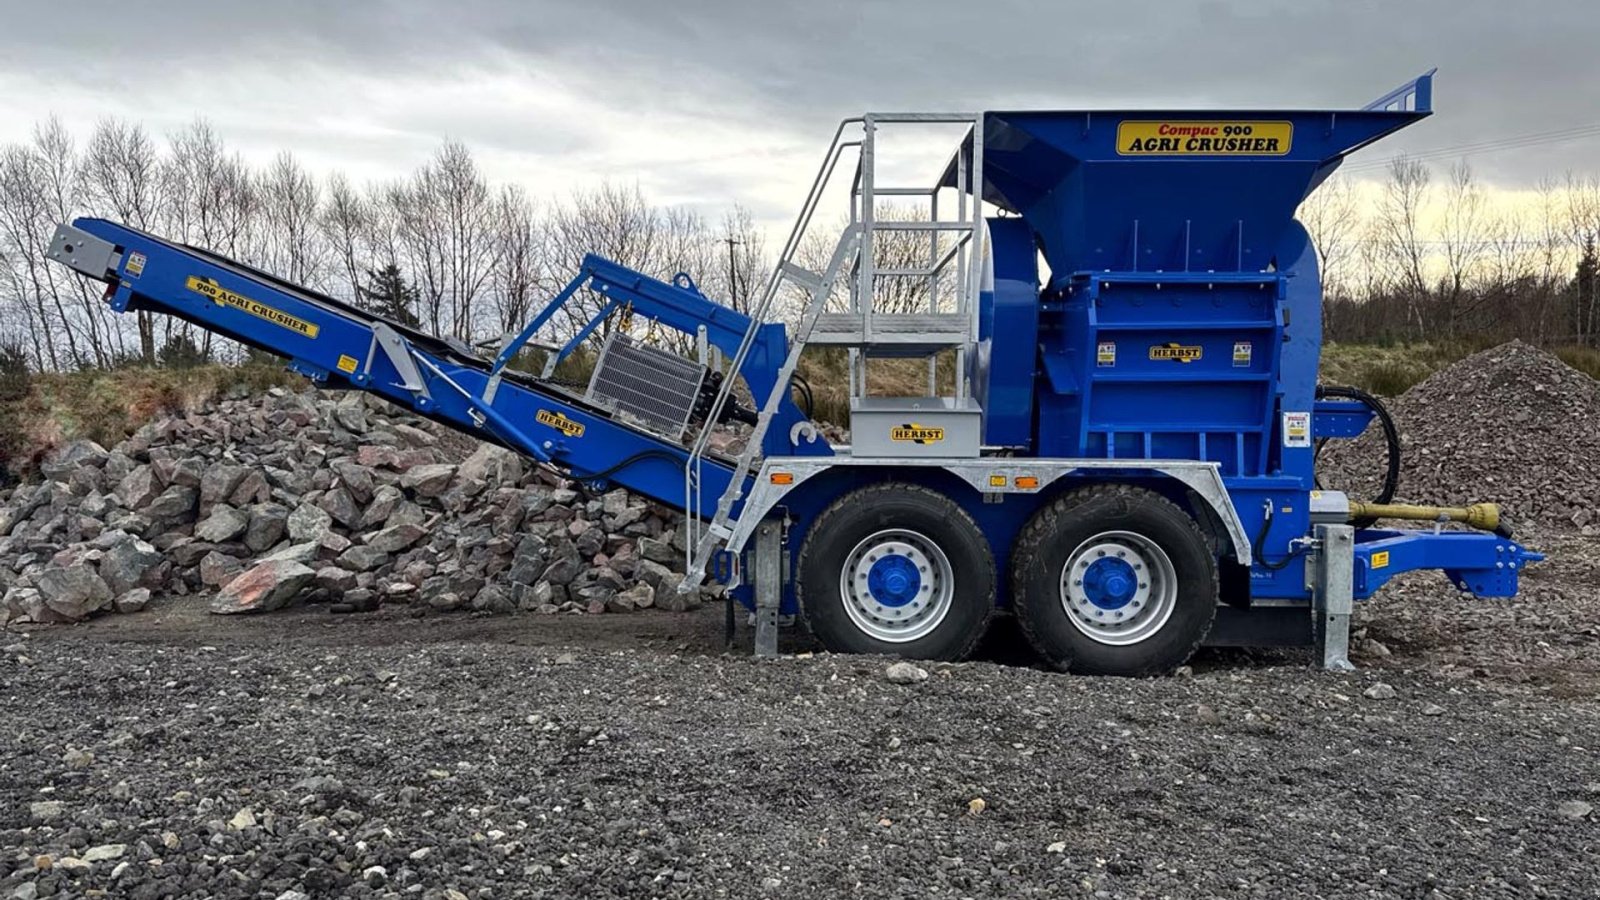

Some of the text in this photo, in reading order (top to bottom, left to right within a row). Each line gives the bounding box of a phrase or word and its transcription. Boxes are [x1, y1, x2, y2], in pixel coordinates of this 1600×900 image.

[1158, 124, 1252, 137] Compac 900
[1129, 138, 1279, 151] AGRI CRUSHER
[196, 283, 308, 333] 900 AGRI CRUSHER
[1153, 349, 1199, 357] HERBST
[540, 413, 582, 433] HERBST
[895, 430, 941, 438] HERBST
